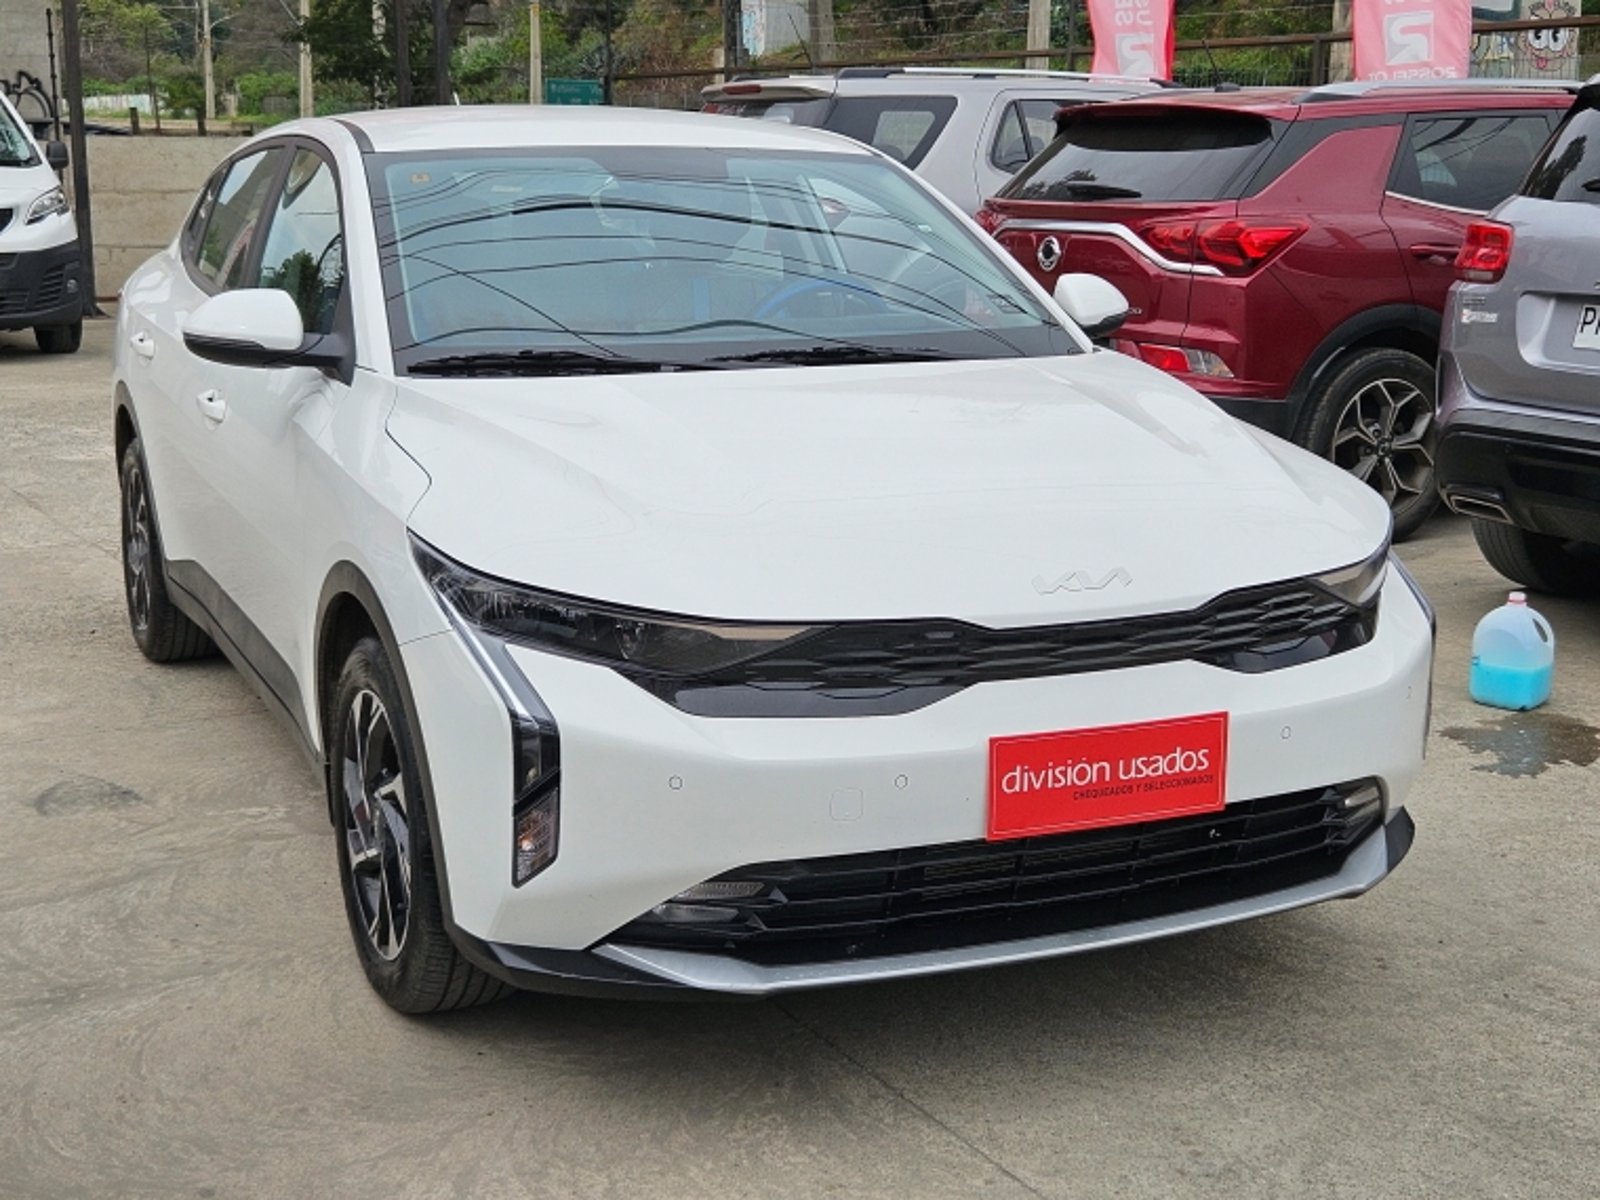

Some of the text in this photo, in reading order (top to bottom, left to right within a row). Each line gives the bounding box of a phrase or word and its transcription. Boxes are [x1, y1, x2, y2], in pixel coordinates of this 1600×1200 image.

[1580, 306, 1600, 335] P
[1001, 746, 1209, 793] división usados
[1136, 782, 1142, 792] Y
[1143, 774, 1214, 793] SELECCIONADOS
